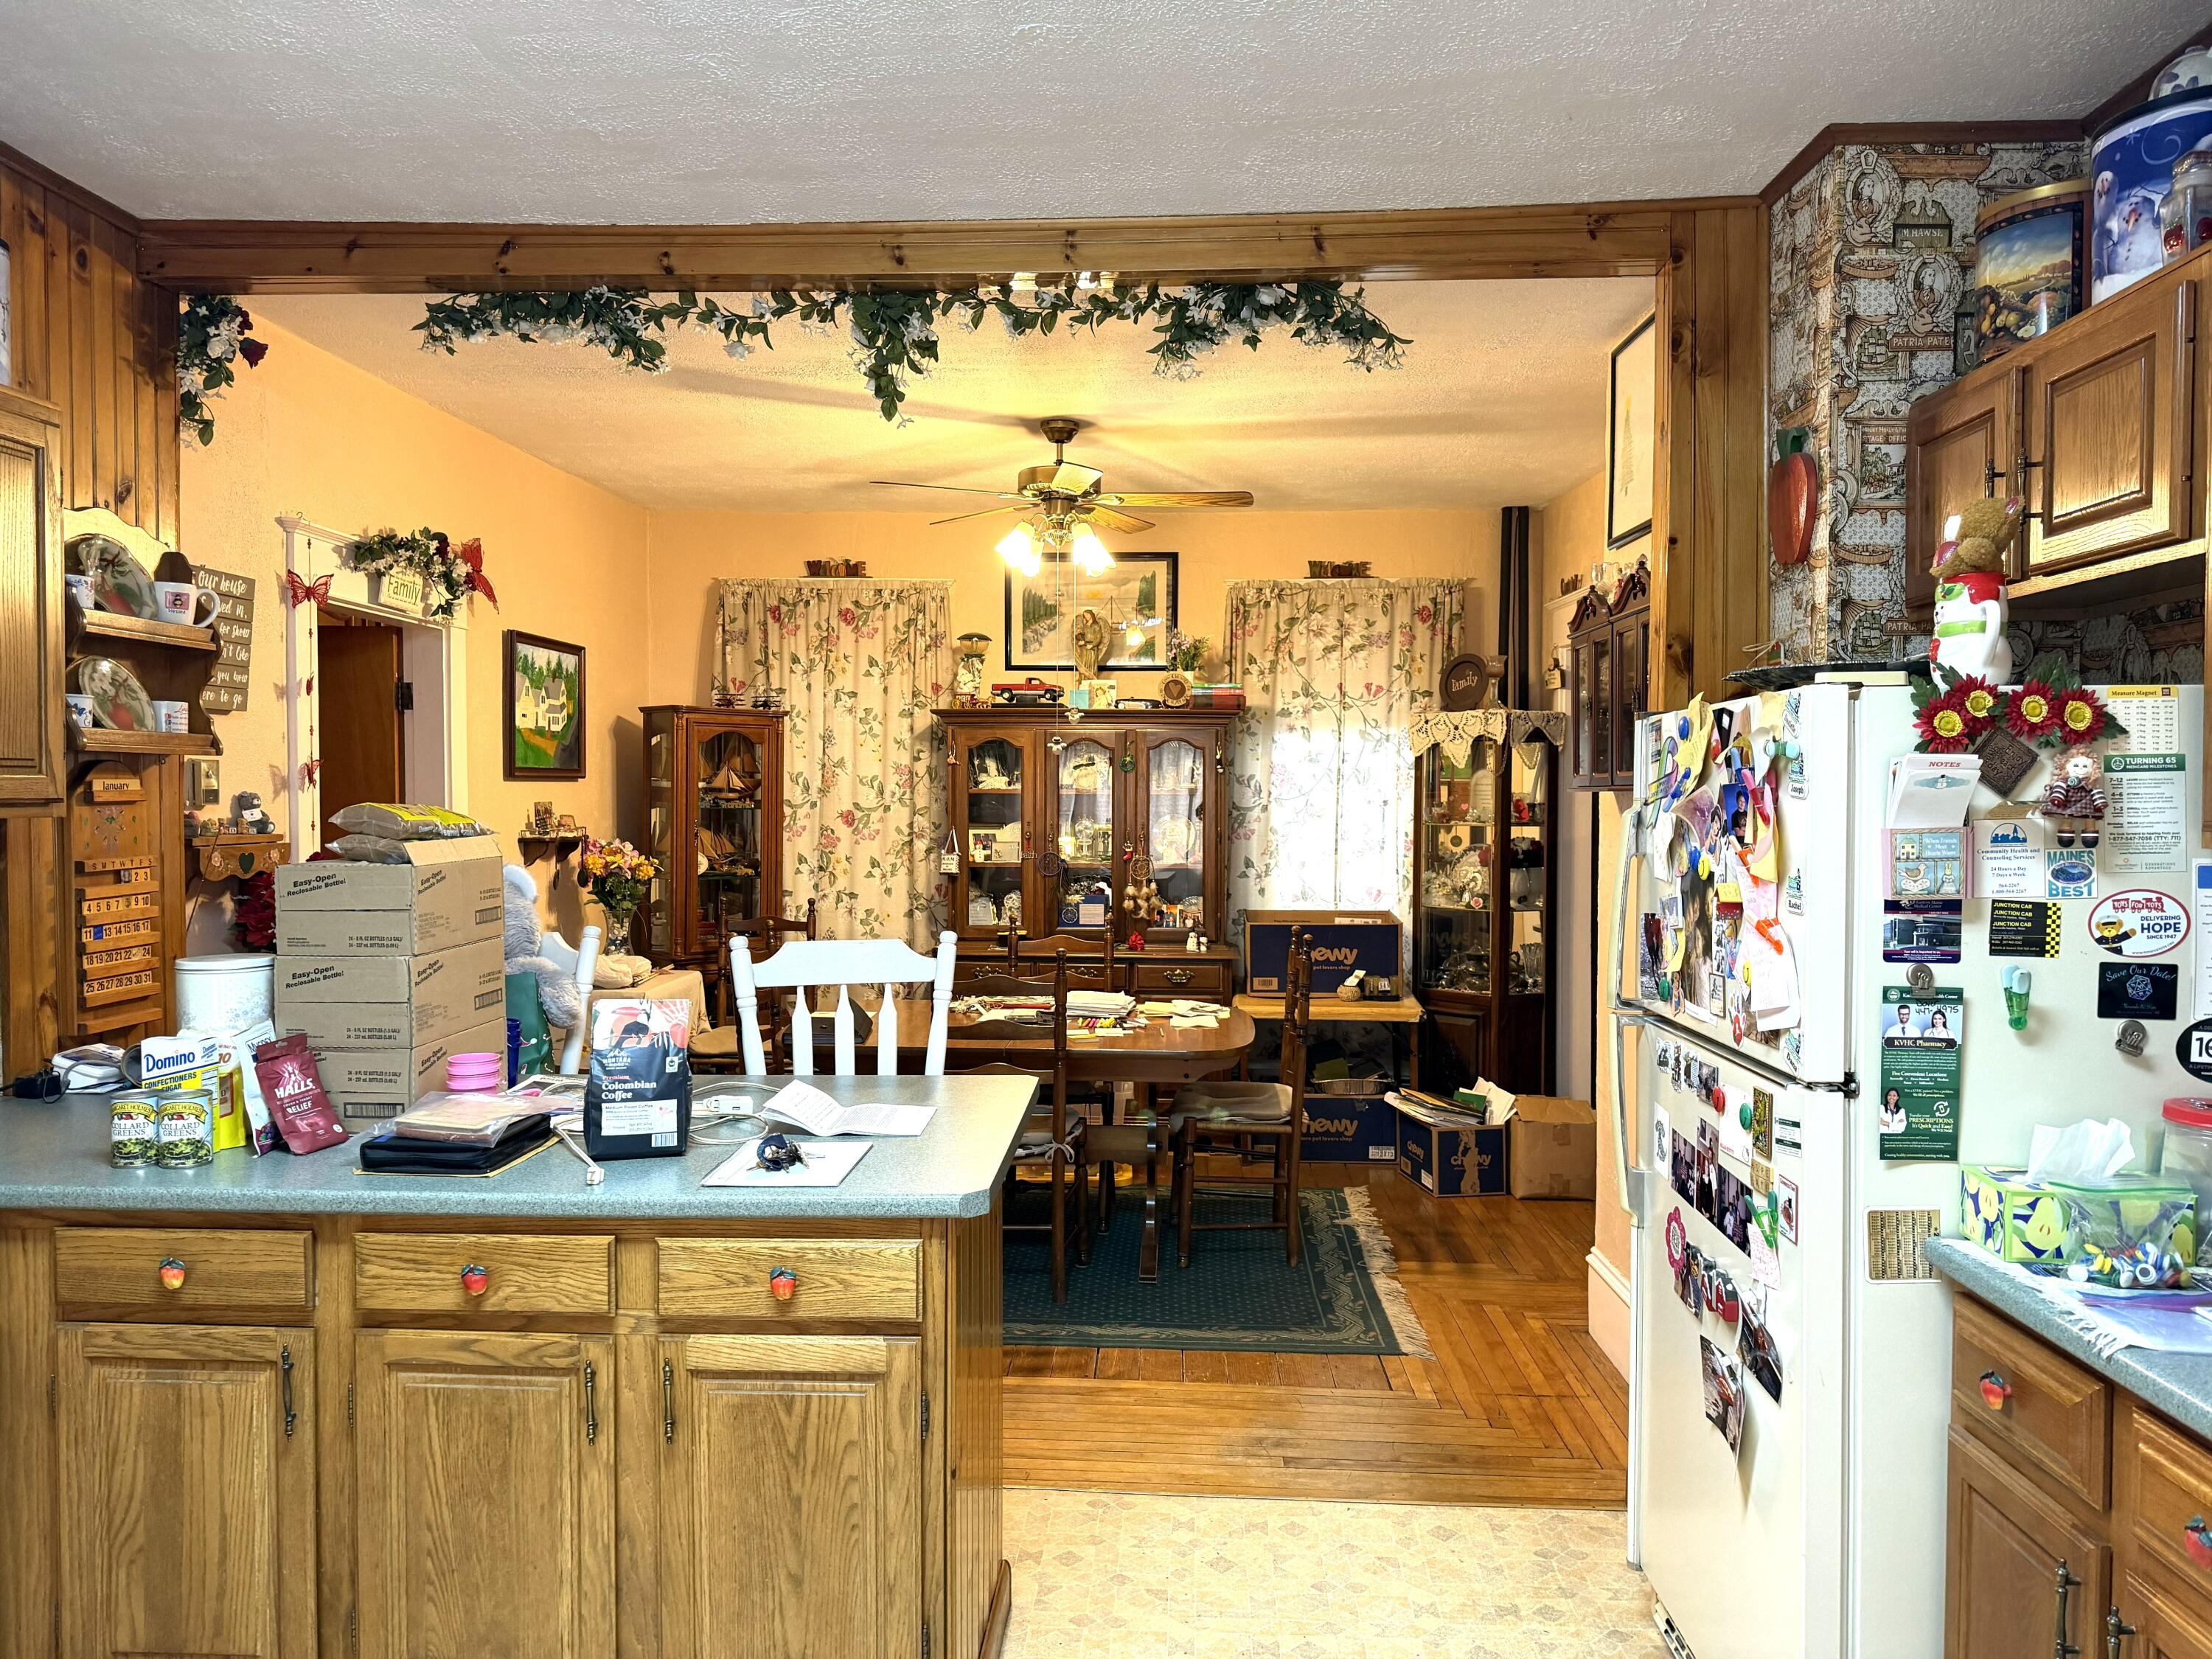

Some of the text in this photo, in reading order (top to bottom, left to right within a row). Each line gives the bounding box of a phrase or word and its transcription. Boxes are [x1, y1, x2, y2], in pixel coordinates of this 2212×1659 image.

[1893, 337, 1924, 347] PATRIA
[198, 571, 247, 596] Our house
[388, 574, 420, 606] Family
[1888, 623, 1918, 631] PATRIA
[1451, 672, 1478, 692] Family
[233, 694, 243, 709] go
[2005, 744, 2026, 765] Enjoy
[103, 782, 130, 791] January
[1791, 784, 1804, 795] Joseph
[92, 862, 97, 870] S
[102, 861, 106, 869] M
[134, 871, 148, 881] 2 3
[293, 873, 337, 888] Easy-Open
[421, 870, 442, 886] Easy-Open
[287, 878, 347, 897] Reclosable Bottle!
[2048, 879, 2095, 897] BEST
[87, 896, 149, 913] 4 5 6 7 9 10
[1788, 900, 1801, 910] Rachel
[84, 921, 149, 939] 11 13 14 15 16 17
[2140, 923, 2181, 933] HOPE
[86, 947, 150, 966] 18 19 20 21 22 24
[1310, 947, 1357, 965] ewy
[292, 966, 335, 980] Easy-Open
[417, 959, 439, 978] Easy-Open
[2106, 964, 2177, 982] Save Our Date!
[86, 973, 150, 993] 25 26 27 28 29 30 31
[285, 970, 344, 989] Reclosable Bottle!
[1937, 1005, 1958, 1013] 4975
[1917, 1040, 1947, 1048] Pharmacy
[144, 1051, 195, 1073] Domino
[421, 1046, 443, 1067] Easy-Open
[1787, 1052, 1798, 1073] Dana
[145, 1071, 197, 1089] CONFECTIONERS
[161, 1083, 182, 1092] SUGAR
[602, 1081, 657, 1090] Colombian
[602, 1091, 633, 1101] Coffee
[130, 1105, 151, 1113] HOLMES
[181, 1105, 202, 1113] HOLMES
[286, 1101, 313, 1114] RELIEF
[112, 1121, 150, 1130] COLLARD
[161, 1121, 201, 1130] COLLARD
[163, 1129, 197, 1137] GREENS
[1301, 1117, 1358, 1136] hewy
[1407, 1140, 1425, 1160] chewy
